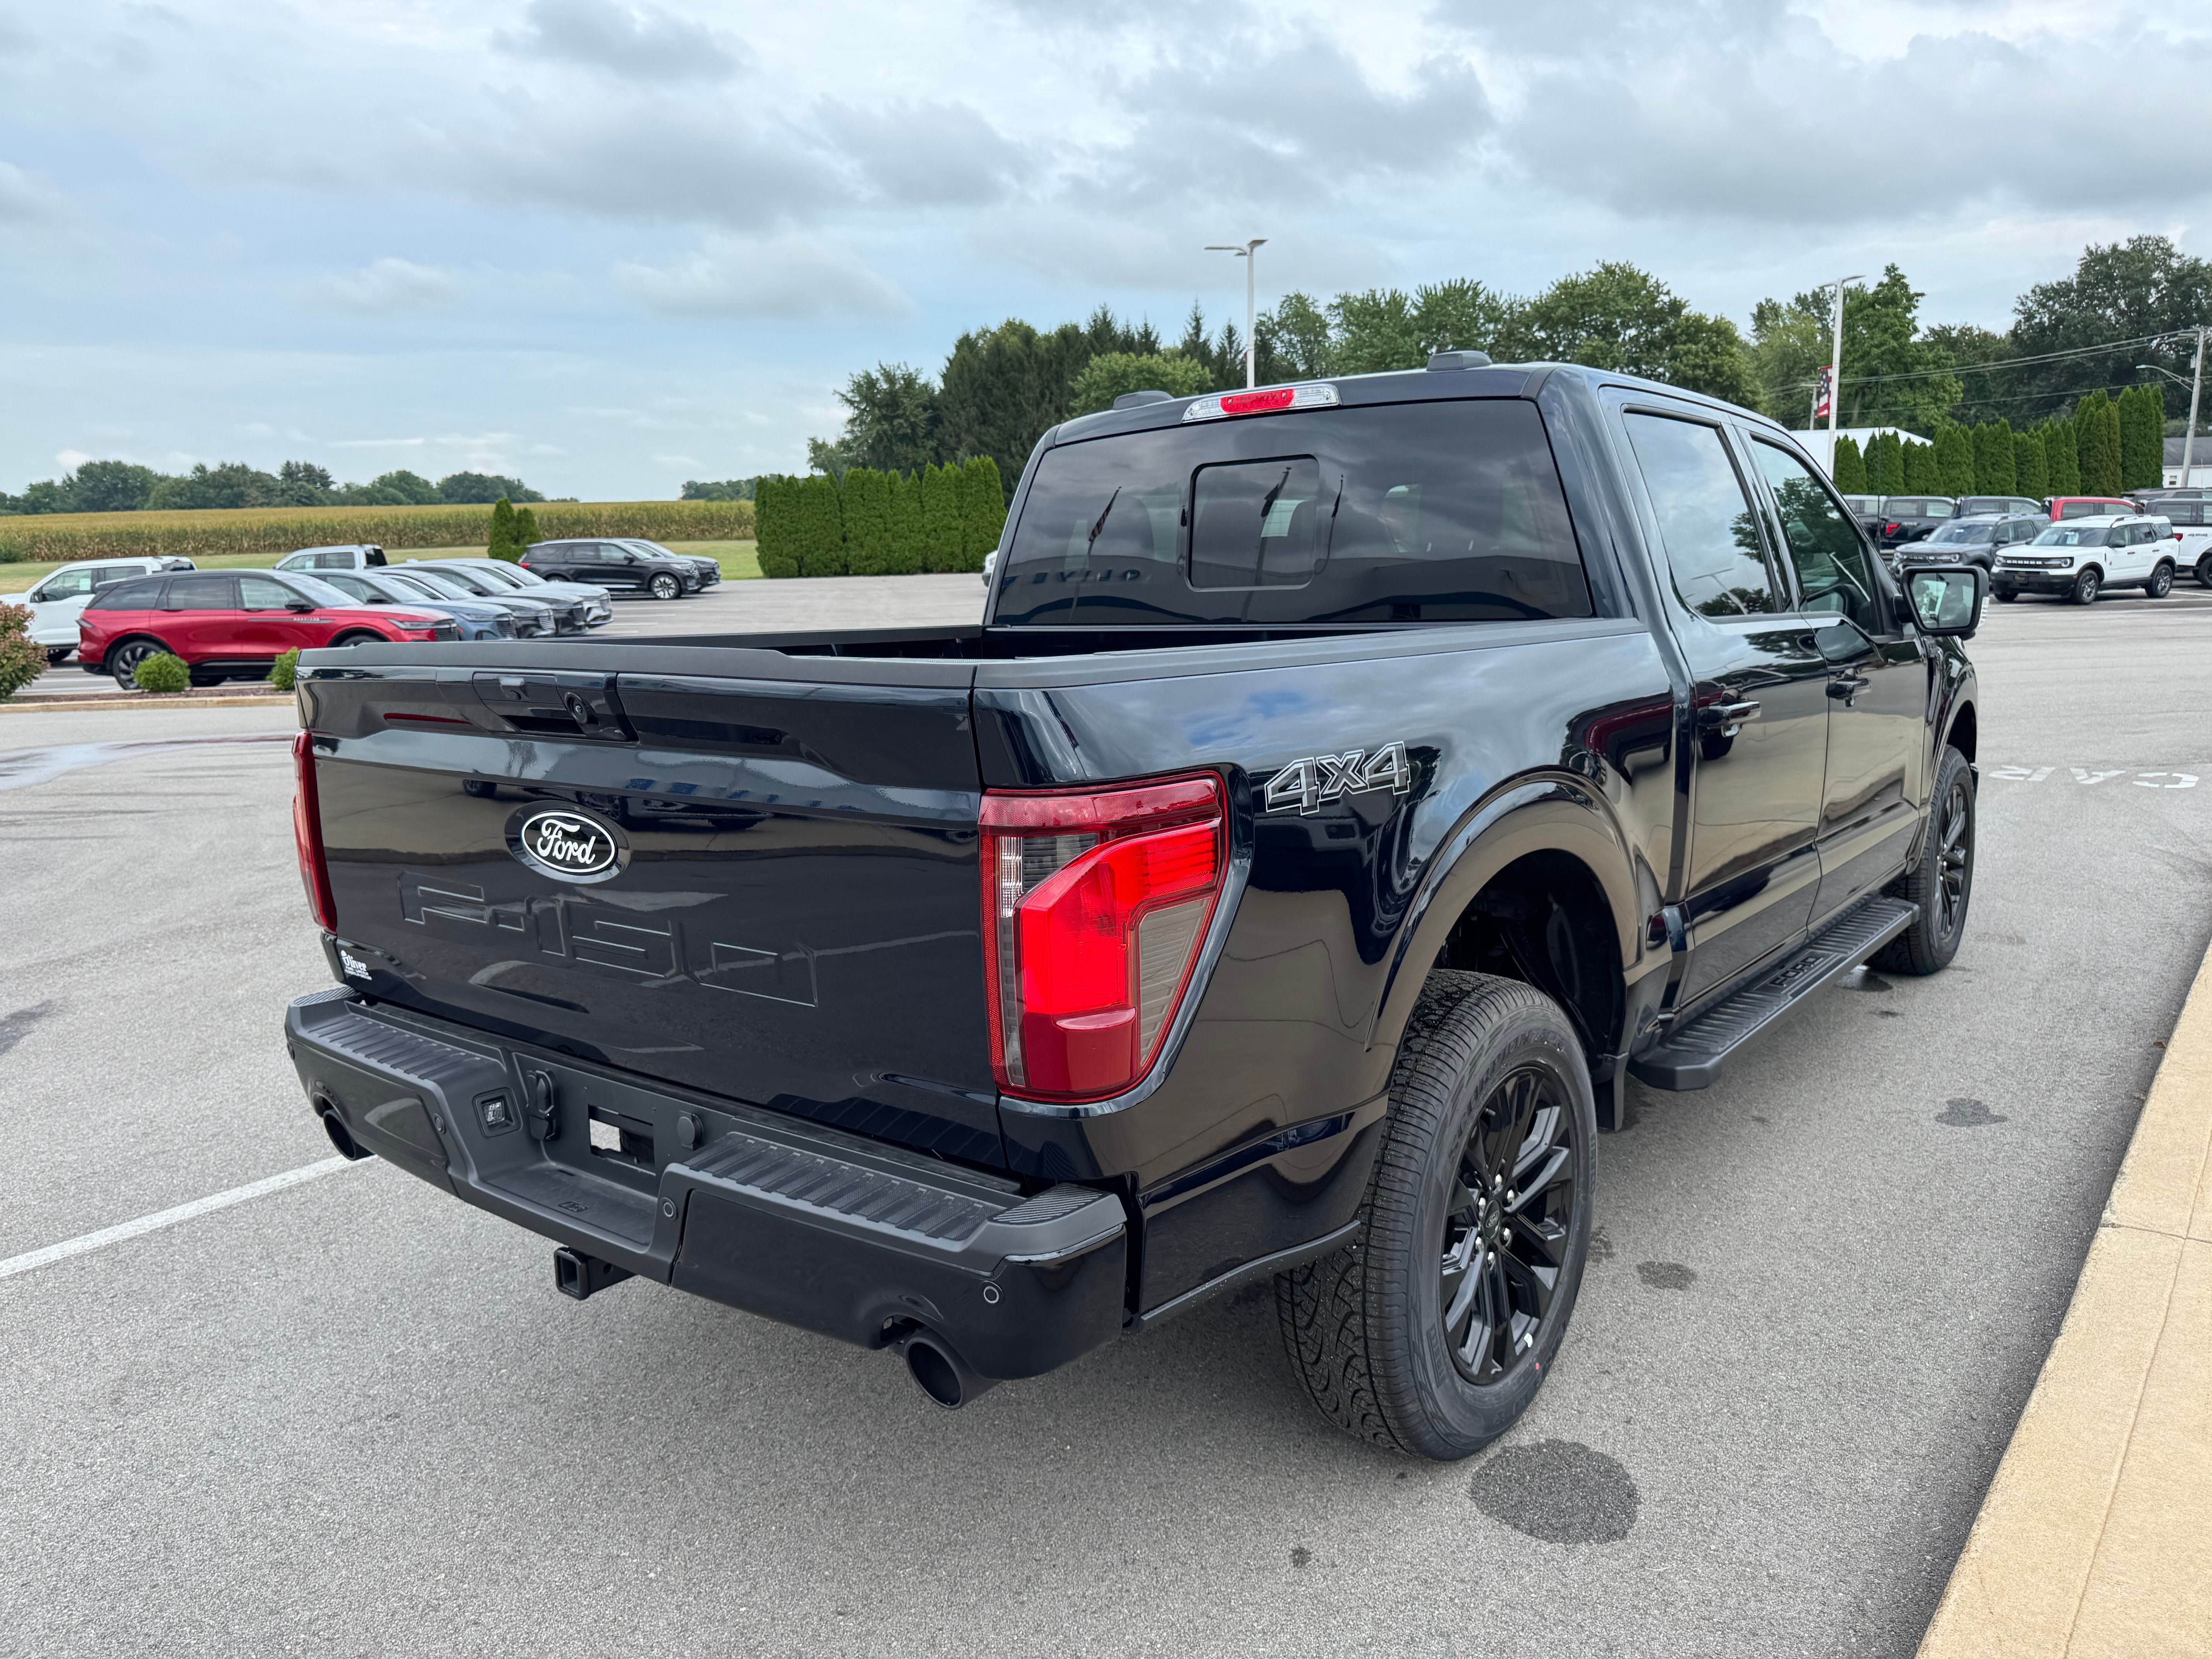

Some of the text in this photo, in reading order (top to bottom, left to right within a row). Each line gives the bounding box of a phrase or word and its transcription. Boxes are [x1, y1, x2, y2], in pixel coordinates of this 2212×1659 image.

[537, 819, 596, 864] Ford
[397, 870, 817, 1007] F-150
[1769, 956, 1823, 987] FORD
